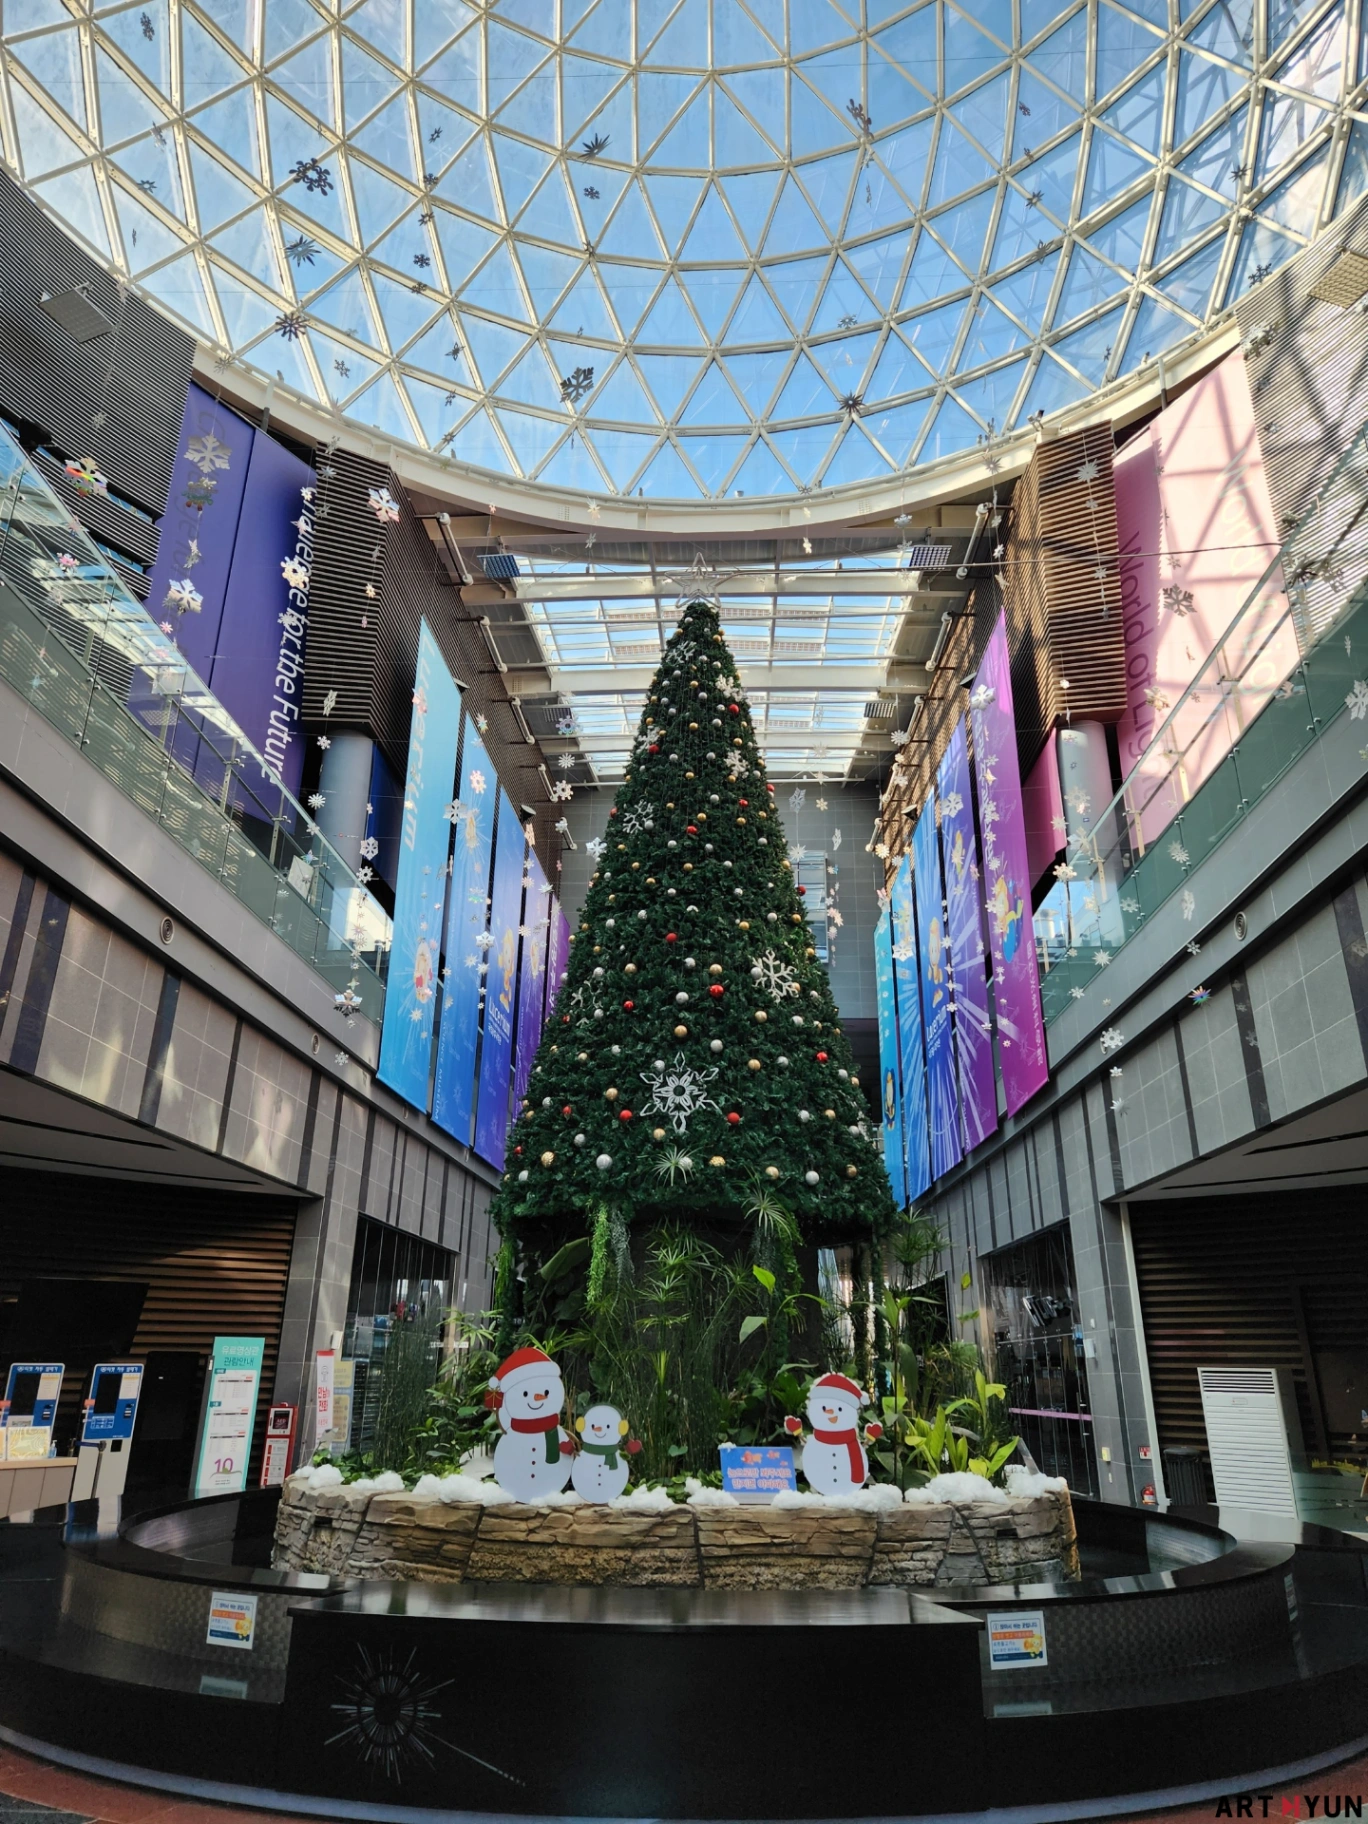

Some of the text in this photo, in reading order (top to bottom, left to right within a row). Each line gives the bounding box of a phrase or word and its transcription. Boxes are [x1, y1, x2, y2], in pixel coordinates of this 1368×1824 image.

[1120, 531, 1155, 647] World
[275, 648, 305, 694] the
[261, 694, 299, 785] Future
[404, 633, 435, 852] Luerium
